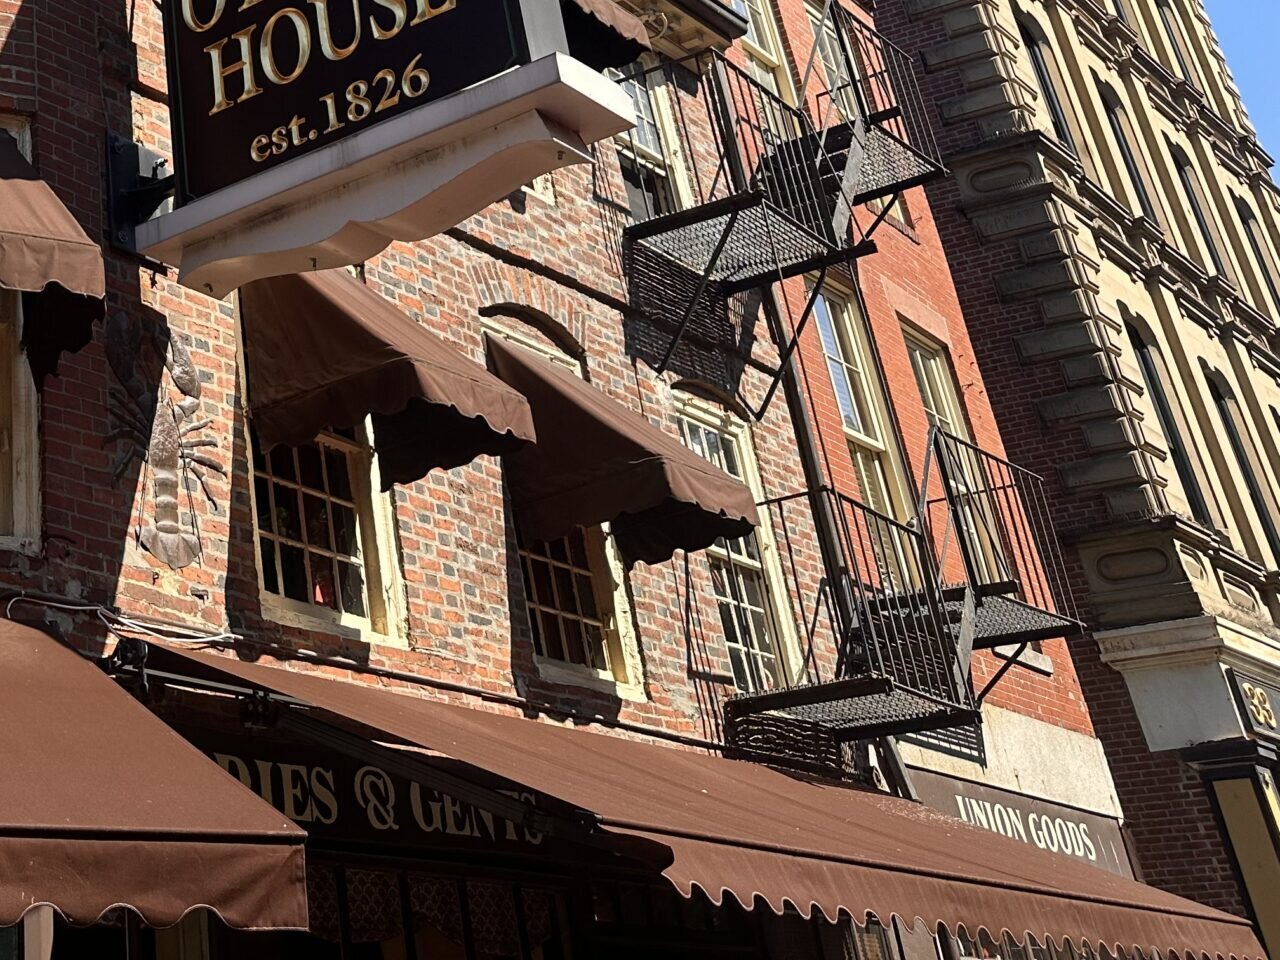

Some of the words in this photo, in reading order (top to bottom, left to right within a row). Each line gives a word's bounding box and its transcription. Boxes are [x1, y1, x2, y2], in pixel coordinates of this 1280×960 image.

[1242, 682, 1277, 730] 33
[354, 766, 399, 830] &
[955, 795, 1028, 844] UNION
[1028, 813, 1097, 861] GOODS
